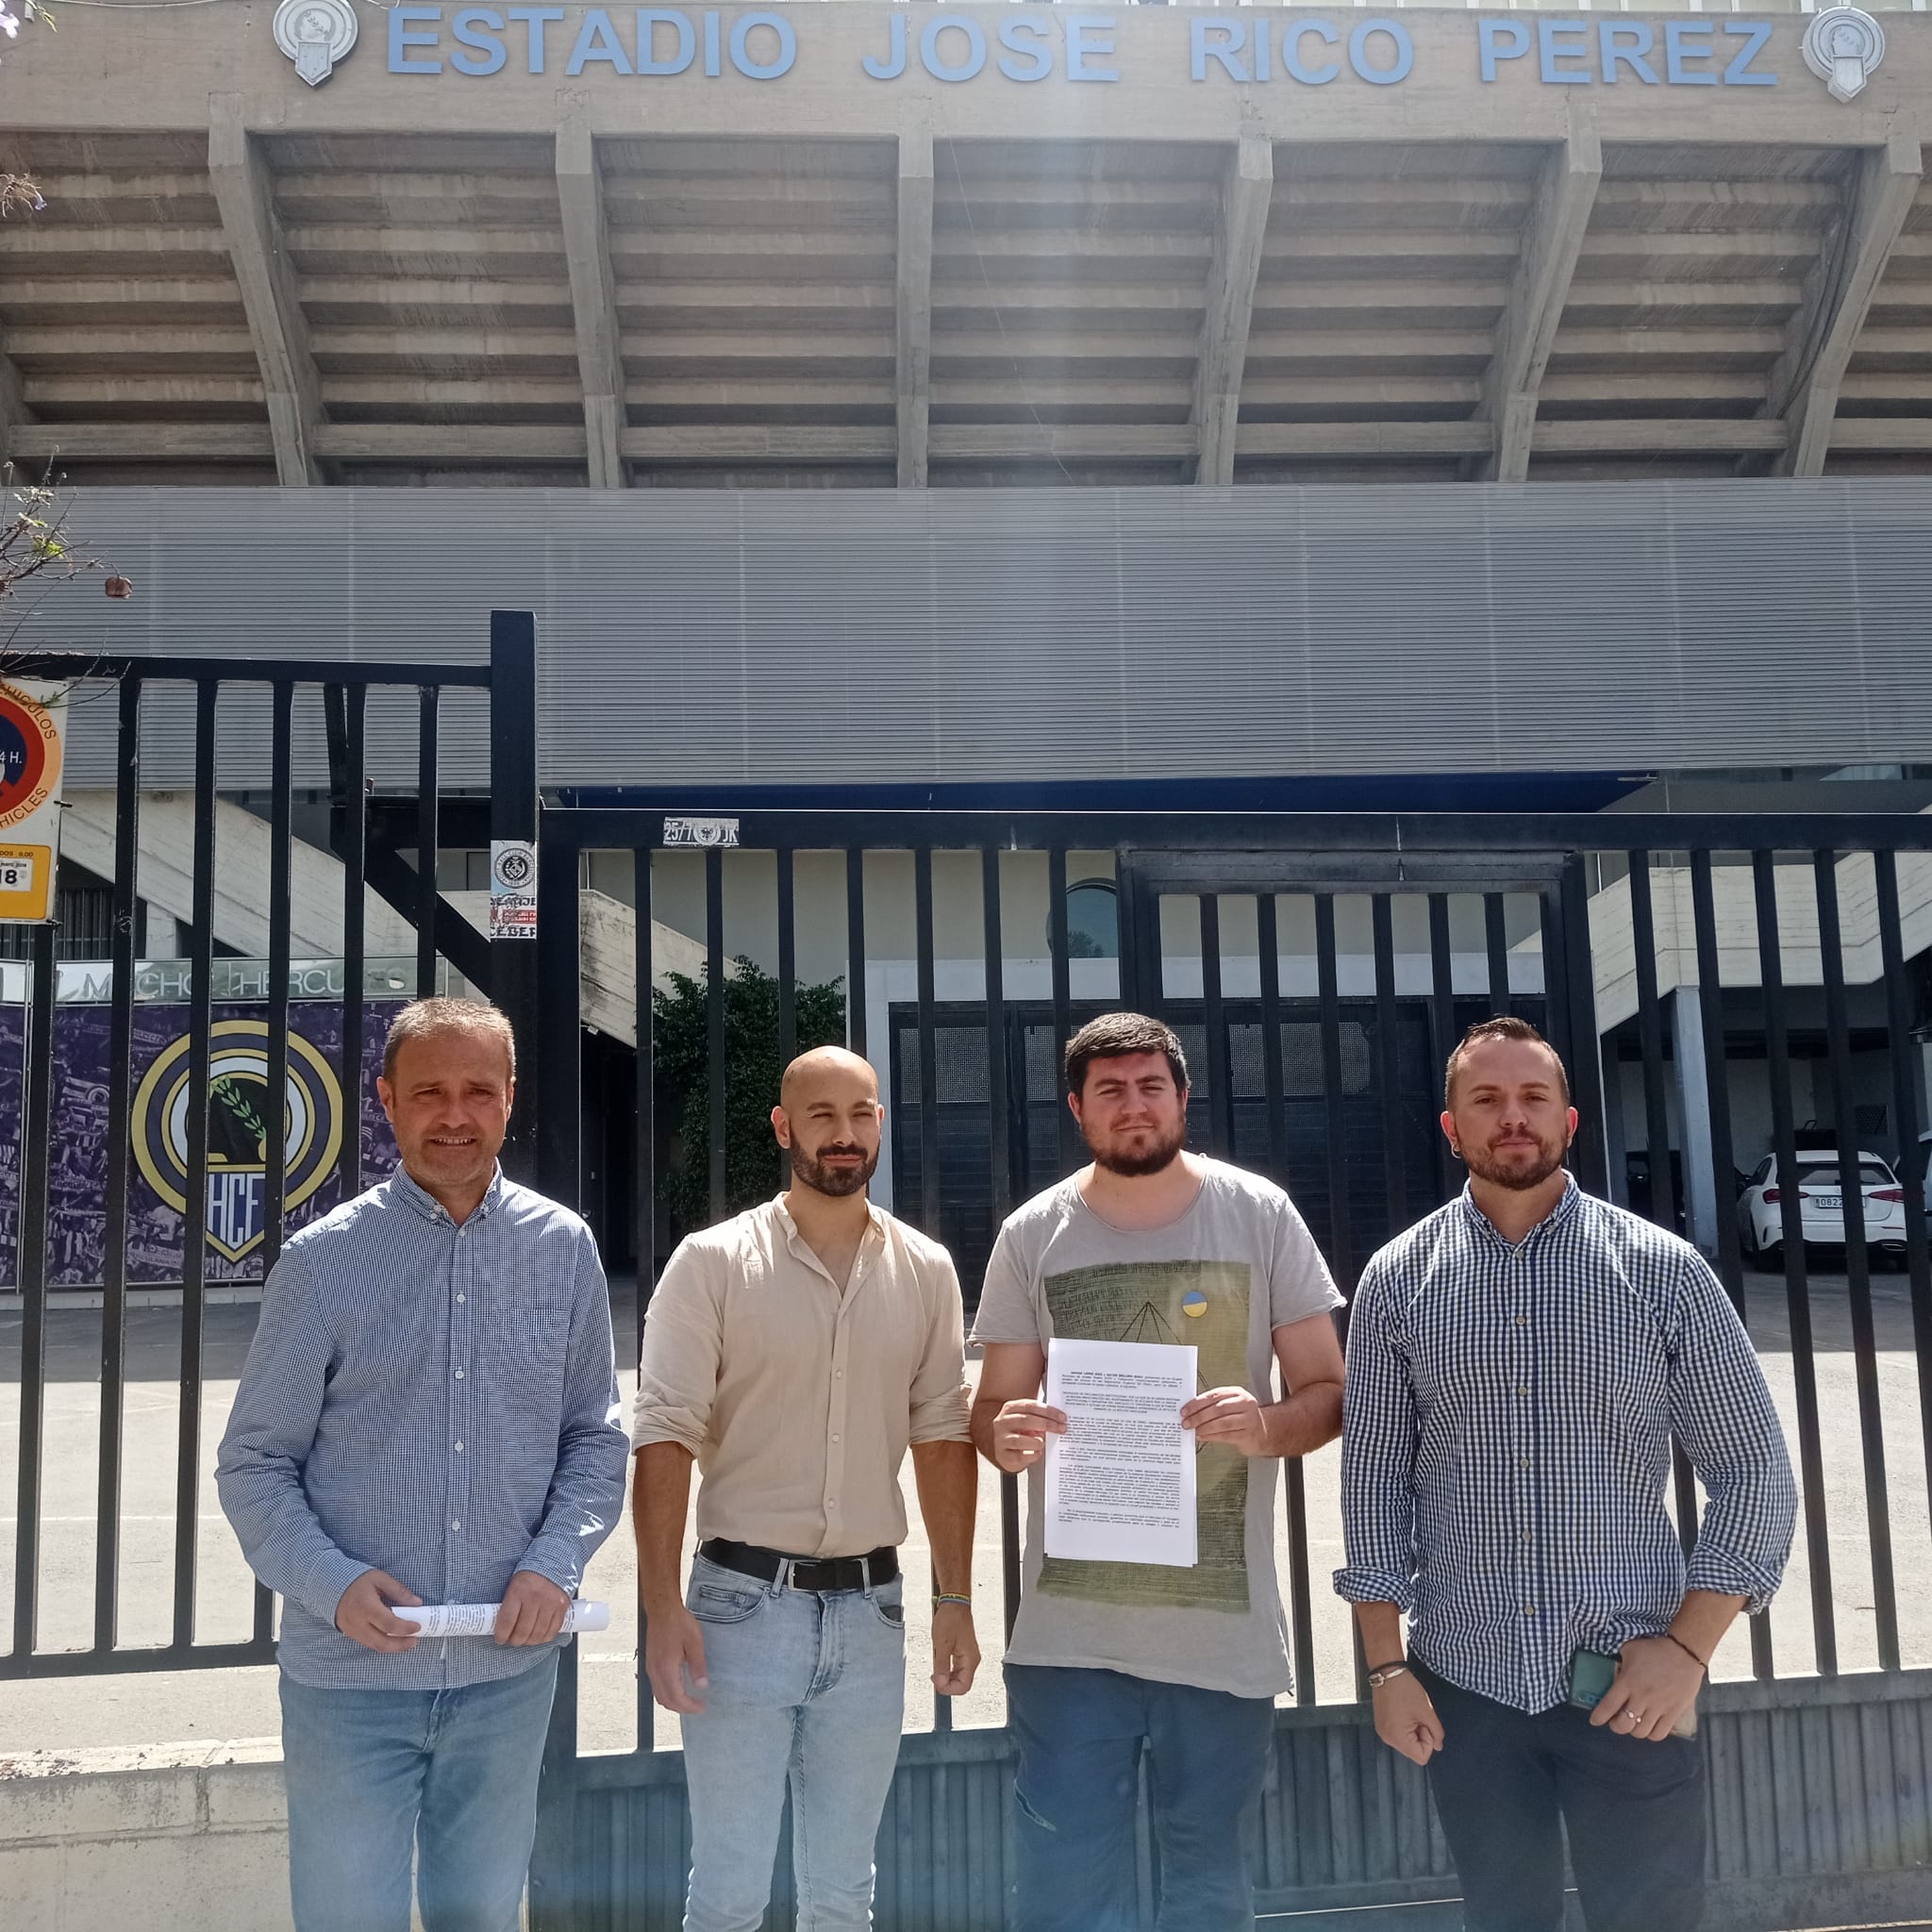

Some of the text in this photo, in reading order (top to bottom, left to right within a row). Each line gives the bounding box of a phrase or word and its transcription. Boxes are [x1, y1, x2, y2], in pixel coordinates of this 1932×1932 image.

[389, 8, 1777, 85] ESTADIO JOSE RICO PEREZ
[0, 788, 48, 827] HICLES
[208, 1173, 265, 1251] HCF
